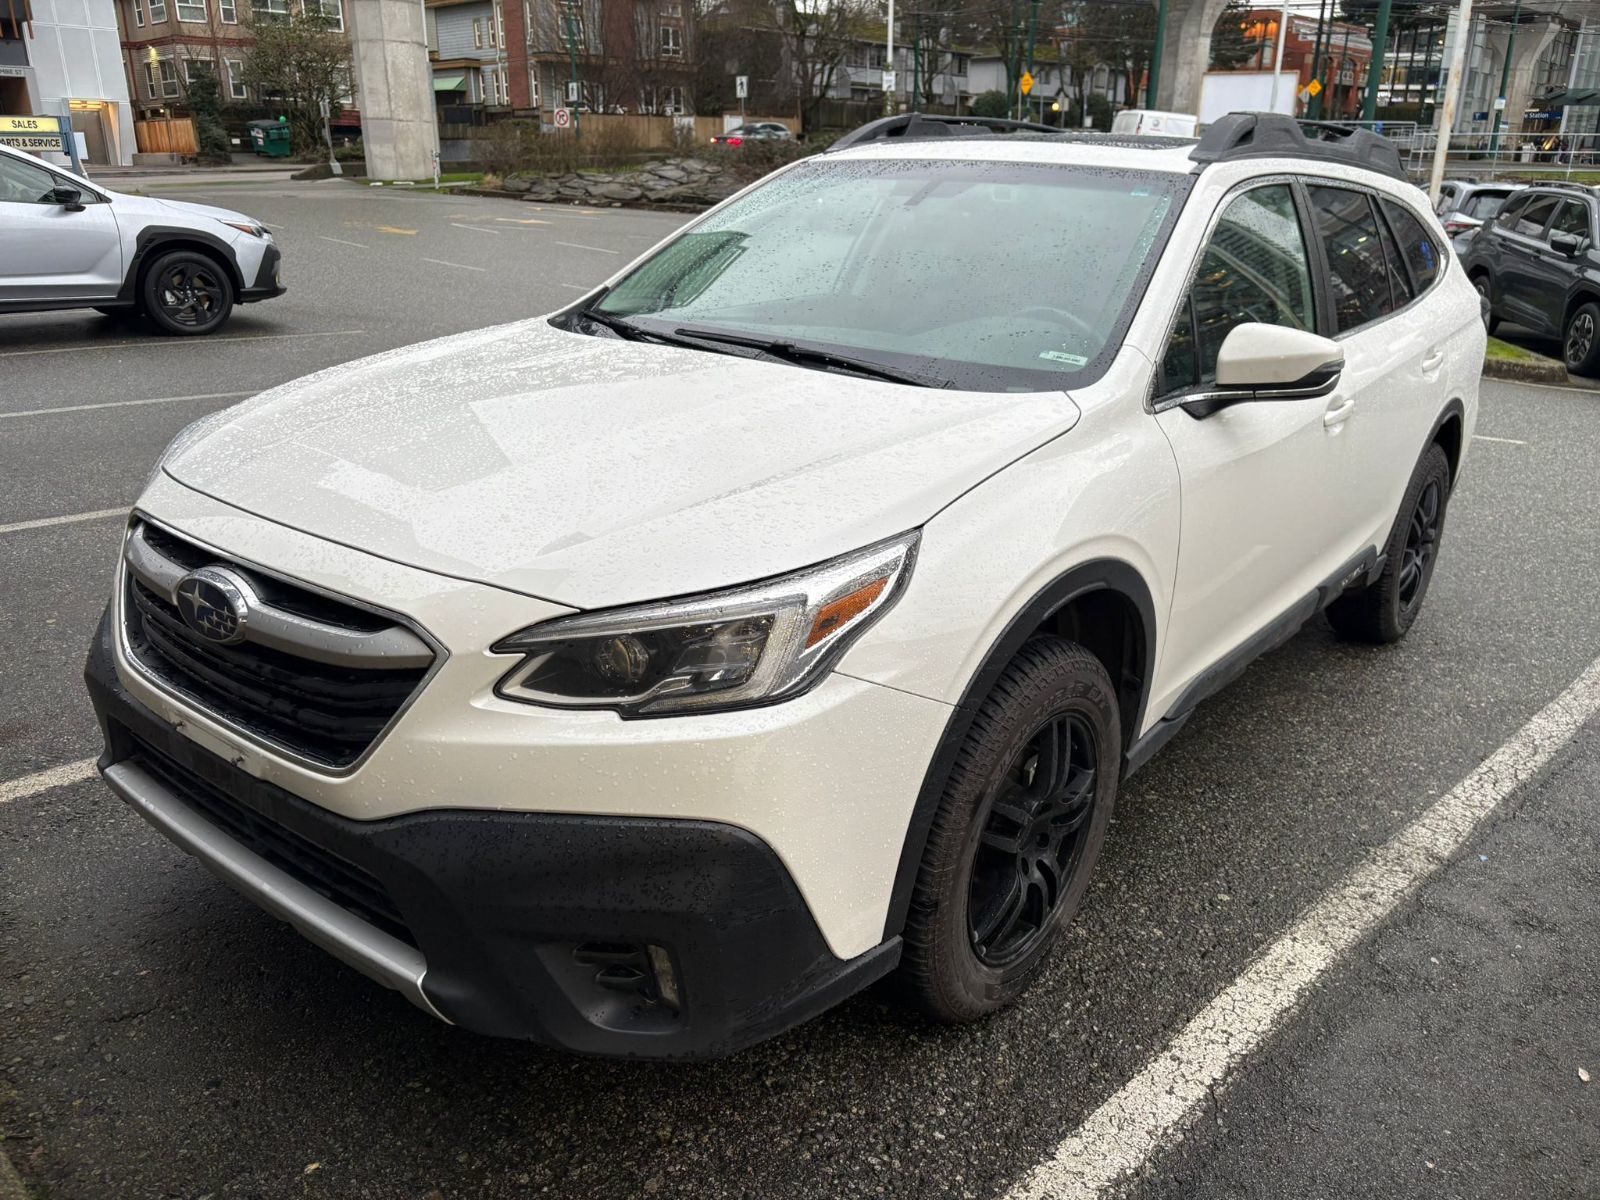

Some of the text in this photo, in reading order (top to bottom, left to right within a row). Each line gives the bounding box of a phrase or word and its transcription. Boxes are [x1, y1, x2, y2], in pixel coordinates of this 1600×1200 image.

[11, 120, 38, 129] SALES
[21, 138, 28, 147] &
[28, 138, 61, 147] SERVICE
